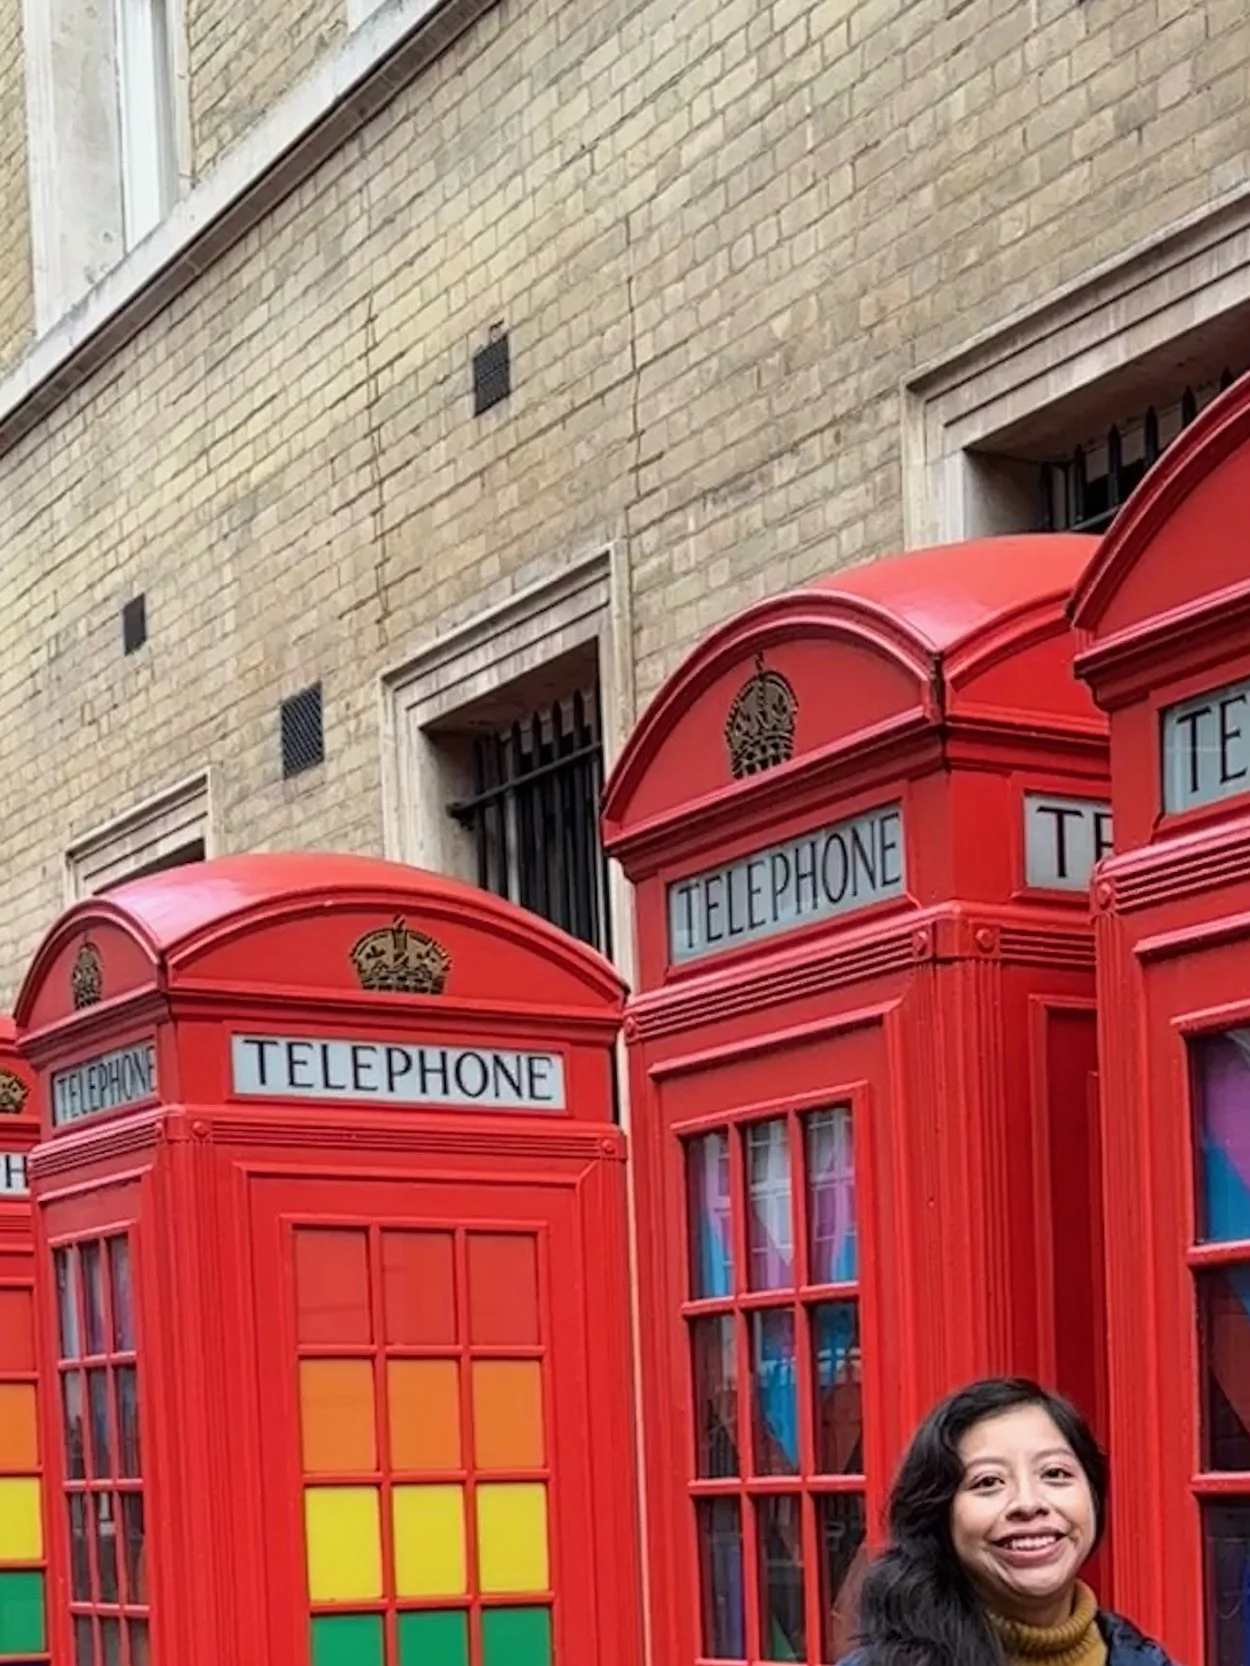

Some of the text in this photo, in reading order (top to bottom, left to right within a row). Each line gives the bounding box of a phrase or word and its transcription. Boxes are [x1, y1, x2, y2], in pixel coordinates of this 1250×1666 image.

[677, 812, 901, 949] TELEPHONE
[57, 1045, 156, 1120] TELEPHONE
[243, 1039, 553, 1101] TELEPHONE
